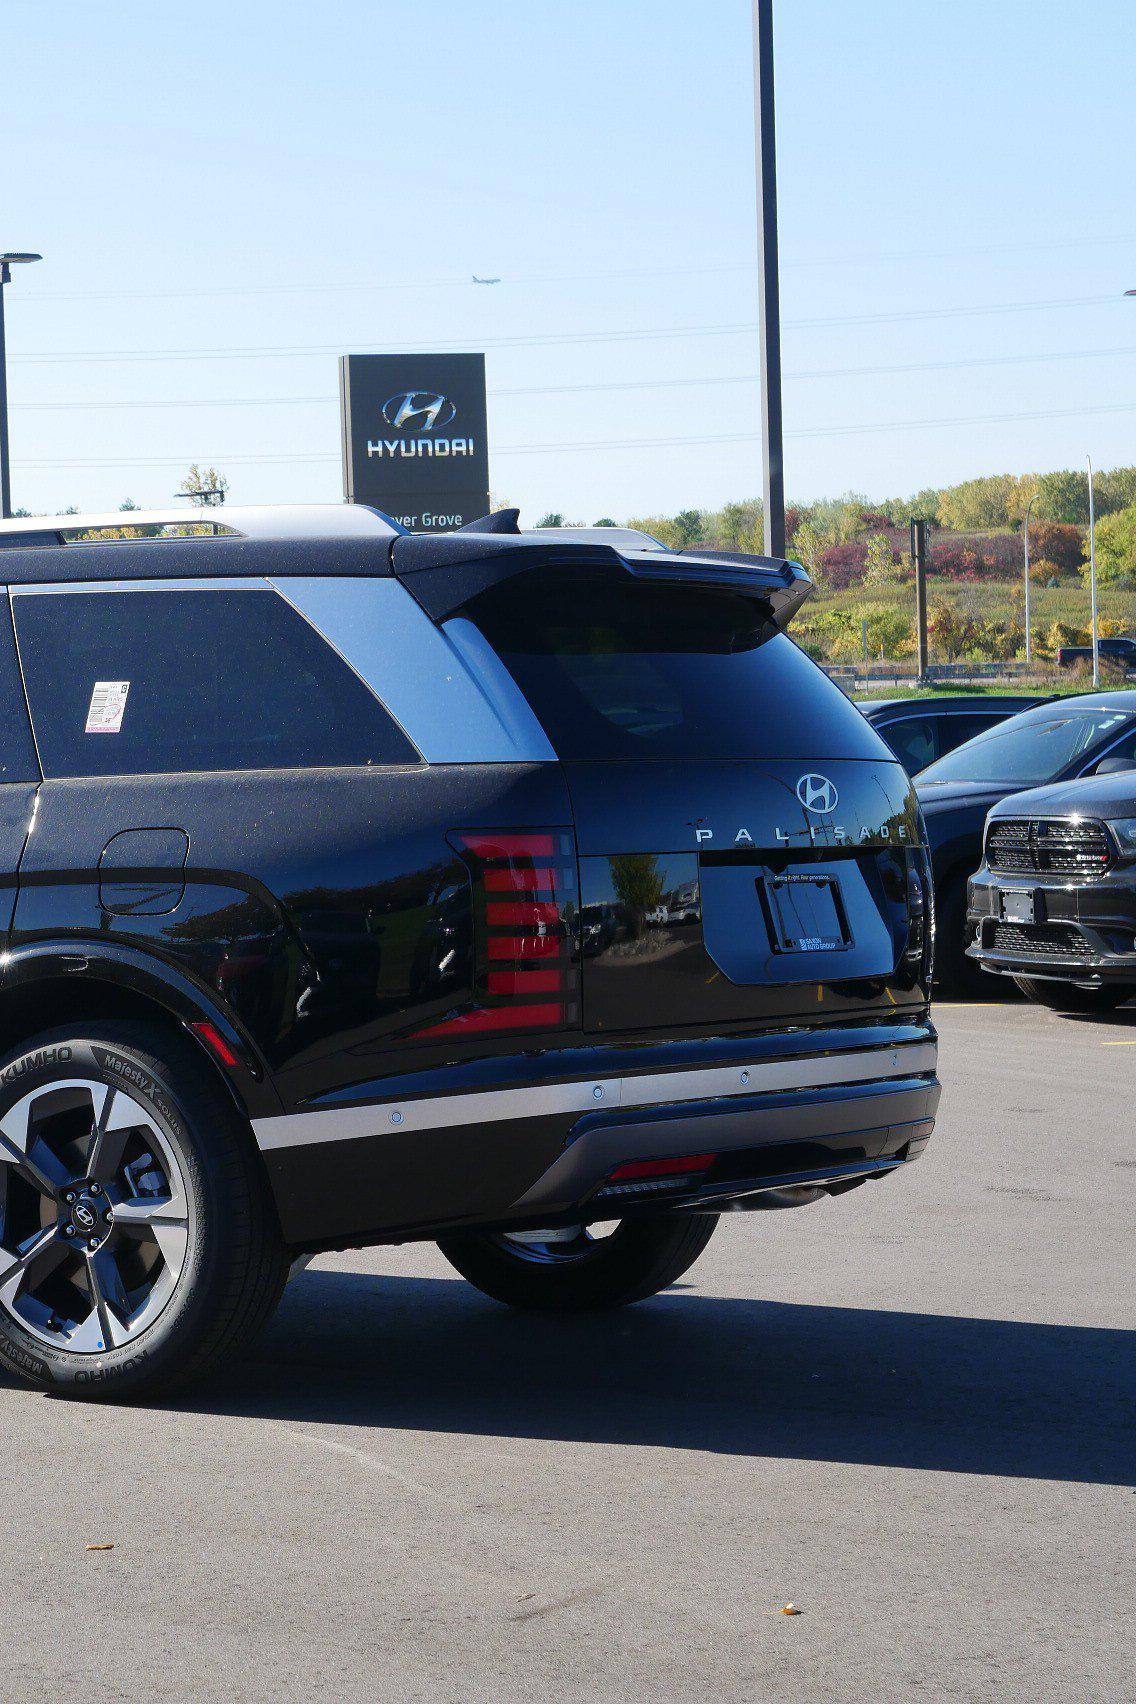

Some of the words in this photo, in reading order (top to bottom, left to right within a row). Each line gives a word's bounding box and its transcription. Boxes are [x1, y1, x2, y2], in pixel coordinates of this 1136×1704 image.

[367, 438, 474, 458] HYUNDAI
[393, 515, 418, 527] ver
[422, 512, 463, 527] Grove
[696, 825, 908, 843] PALISADE
[0, 1046, 73, 1087] KUMHO
[104, 1054, 149, 1091] Majesty
[74, 1350, 148, 1385] KUMHO
